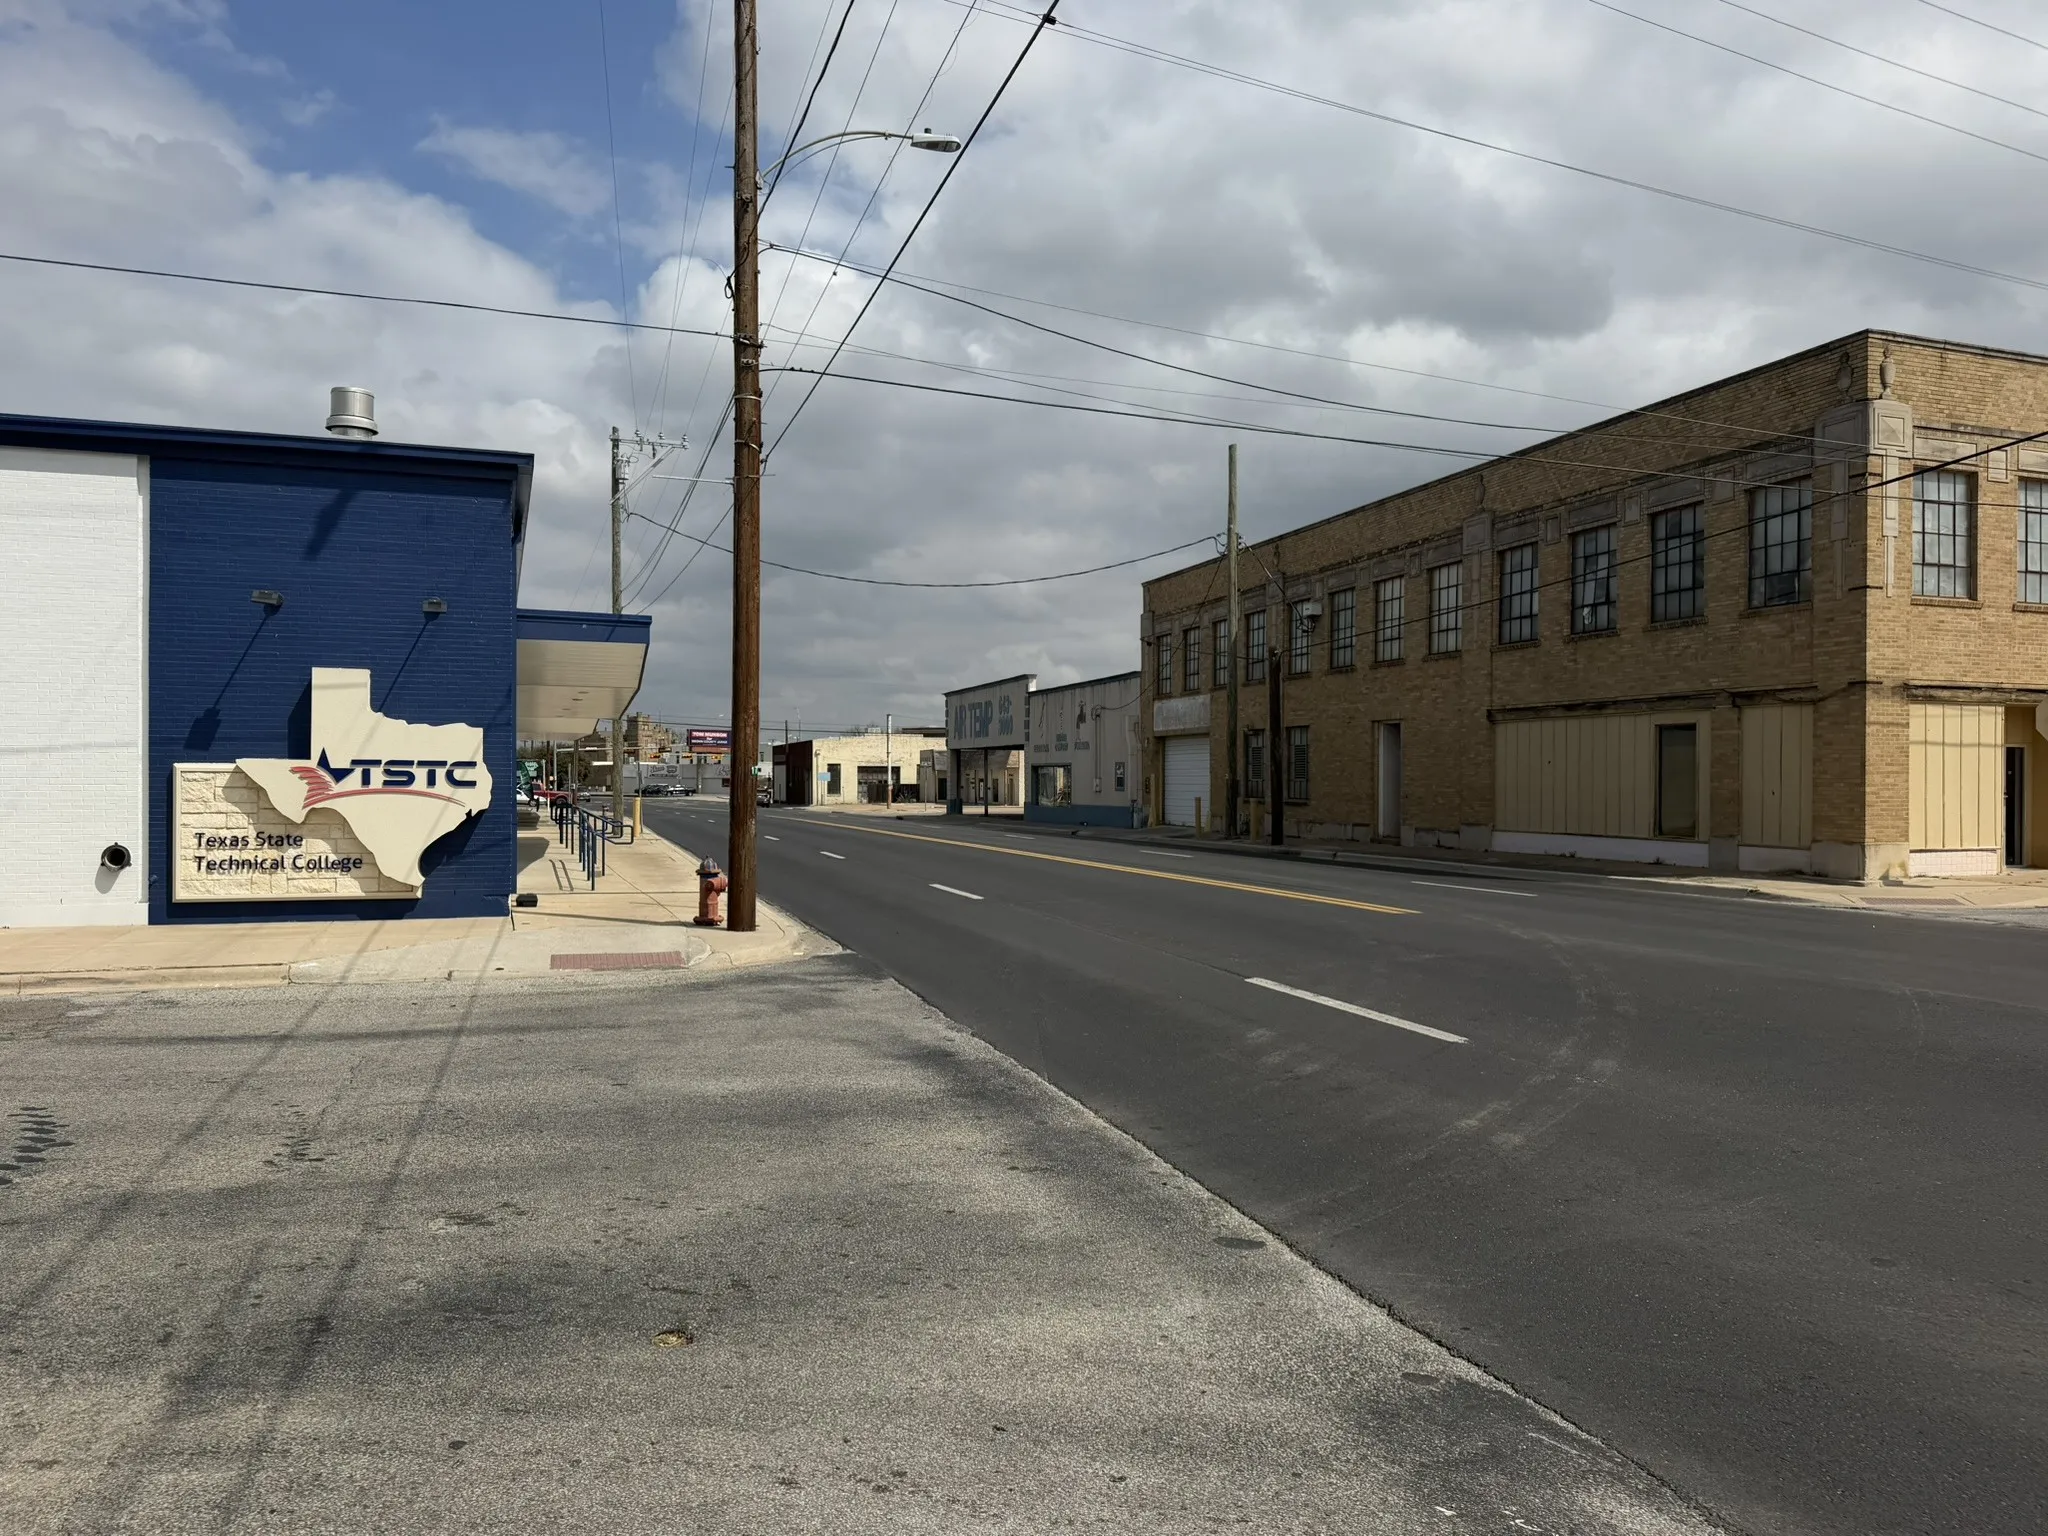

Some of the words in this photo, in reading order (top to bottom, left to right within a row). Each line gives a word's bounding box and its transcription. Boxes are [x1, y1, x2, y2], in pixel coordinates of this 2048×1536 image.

[954, 704, 967, 740] AIR
[968, 700, 993, 738] TEMP
[350, 759, 477, 788] TSTC
[195, 832, 249, 848] Texas
[256, 831, 304, 847] State
[195, 855, 286, 872] Technical
[292, 854, 363, 872] College
